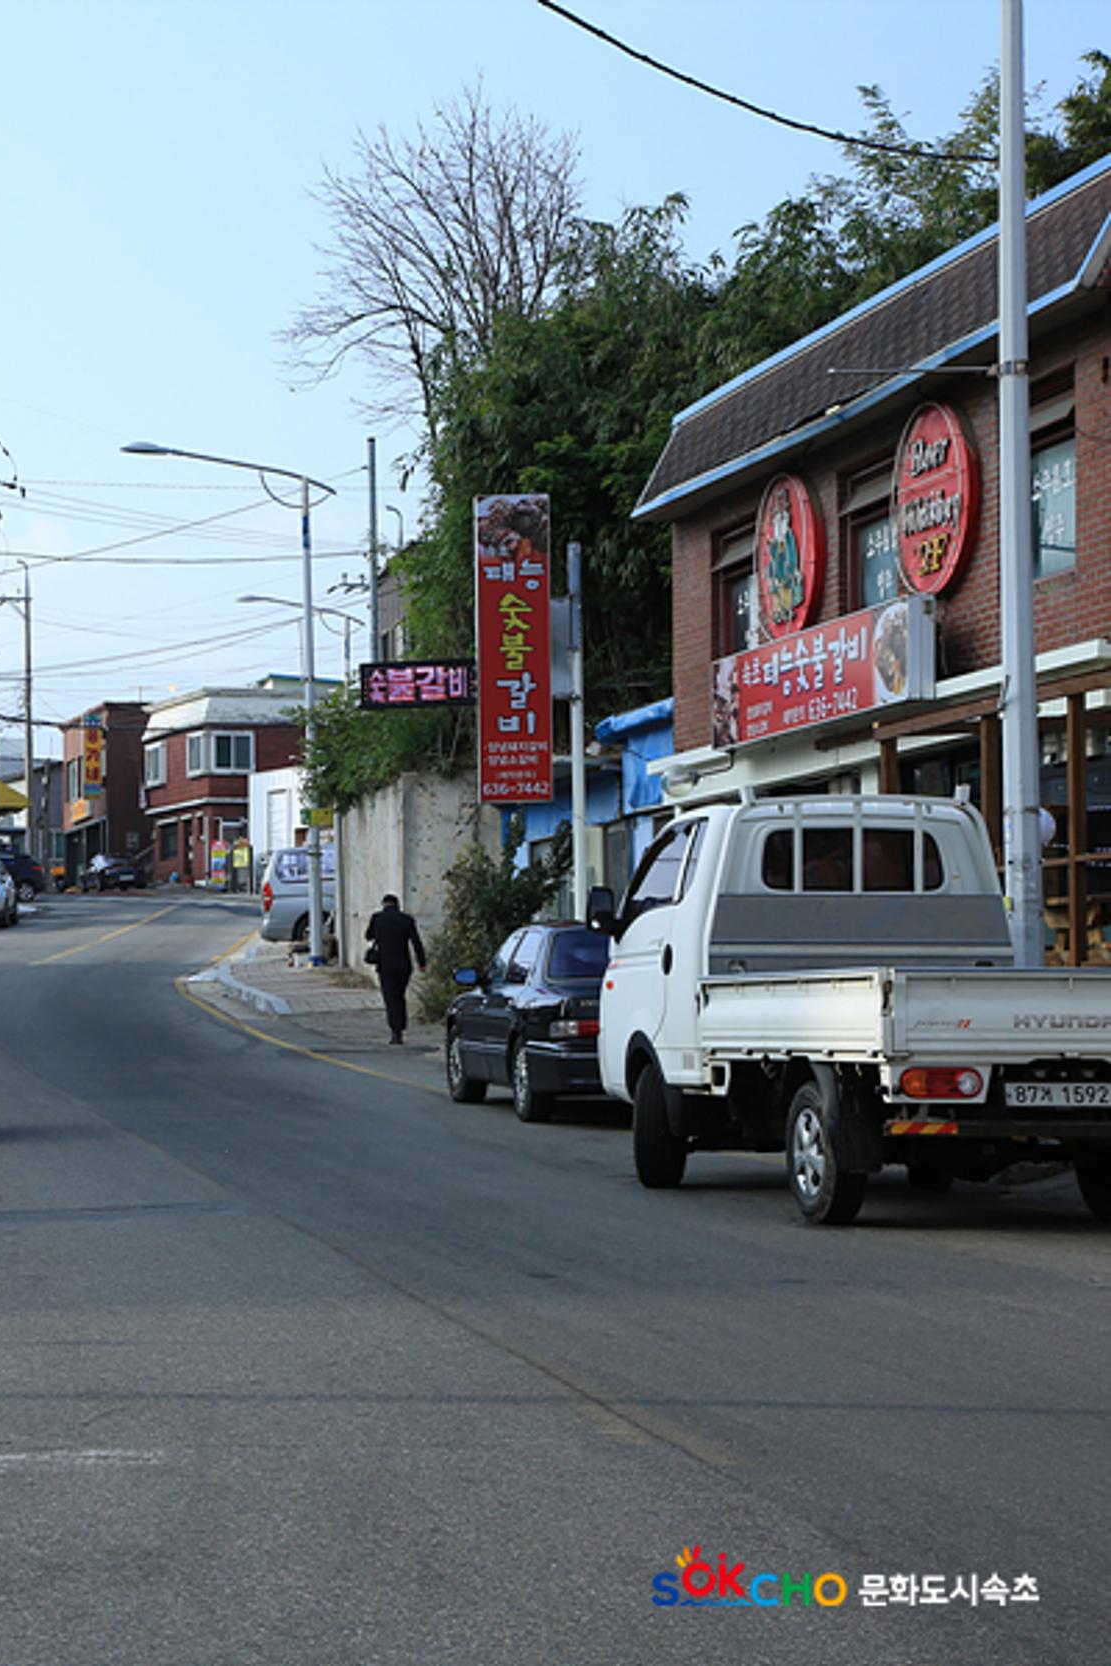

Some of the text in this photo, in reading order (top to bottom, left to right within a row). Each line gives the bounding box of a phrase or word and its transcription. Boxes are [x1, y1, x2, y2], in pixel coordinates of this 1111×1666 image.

[497, 592, 538, 735] 숯불갈비
[368, 666, 468, 702] 숯불갈비
[482, 782, 551, 796] 636-7442
[1061, 1086, 1110, 1104] 1592
